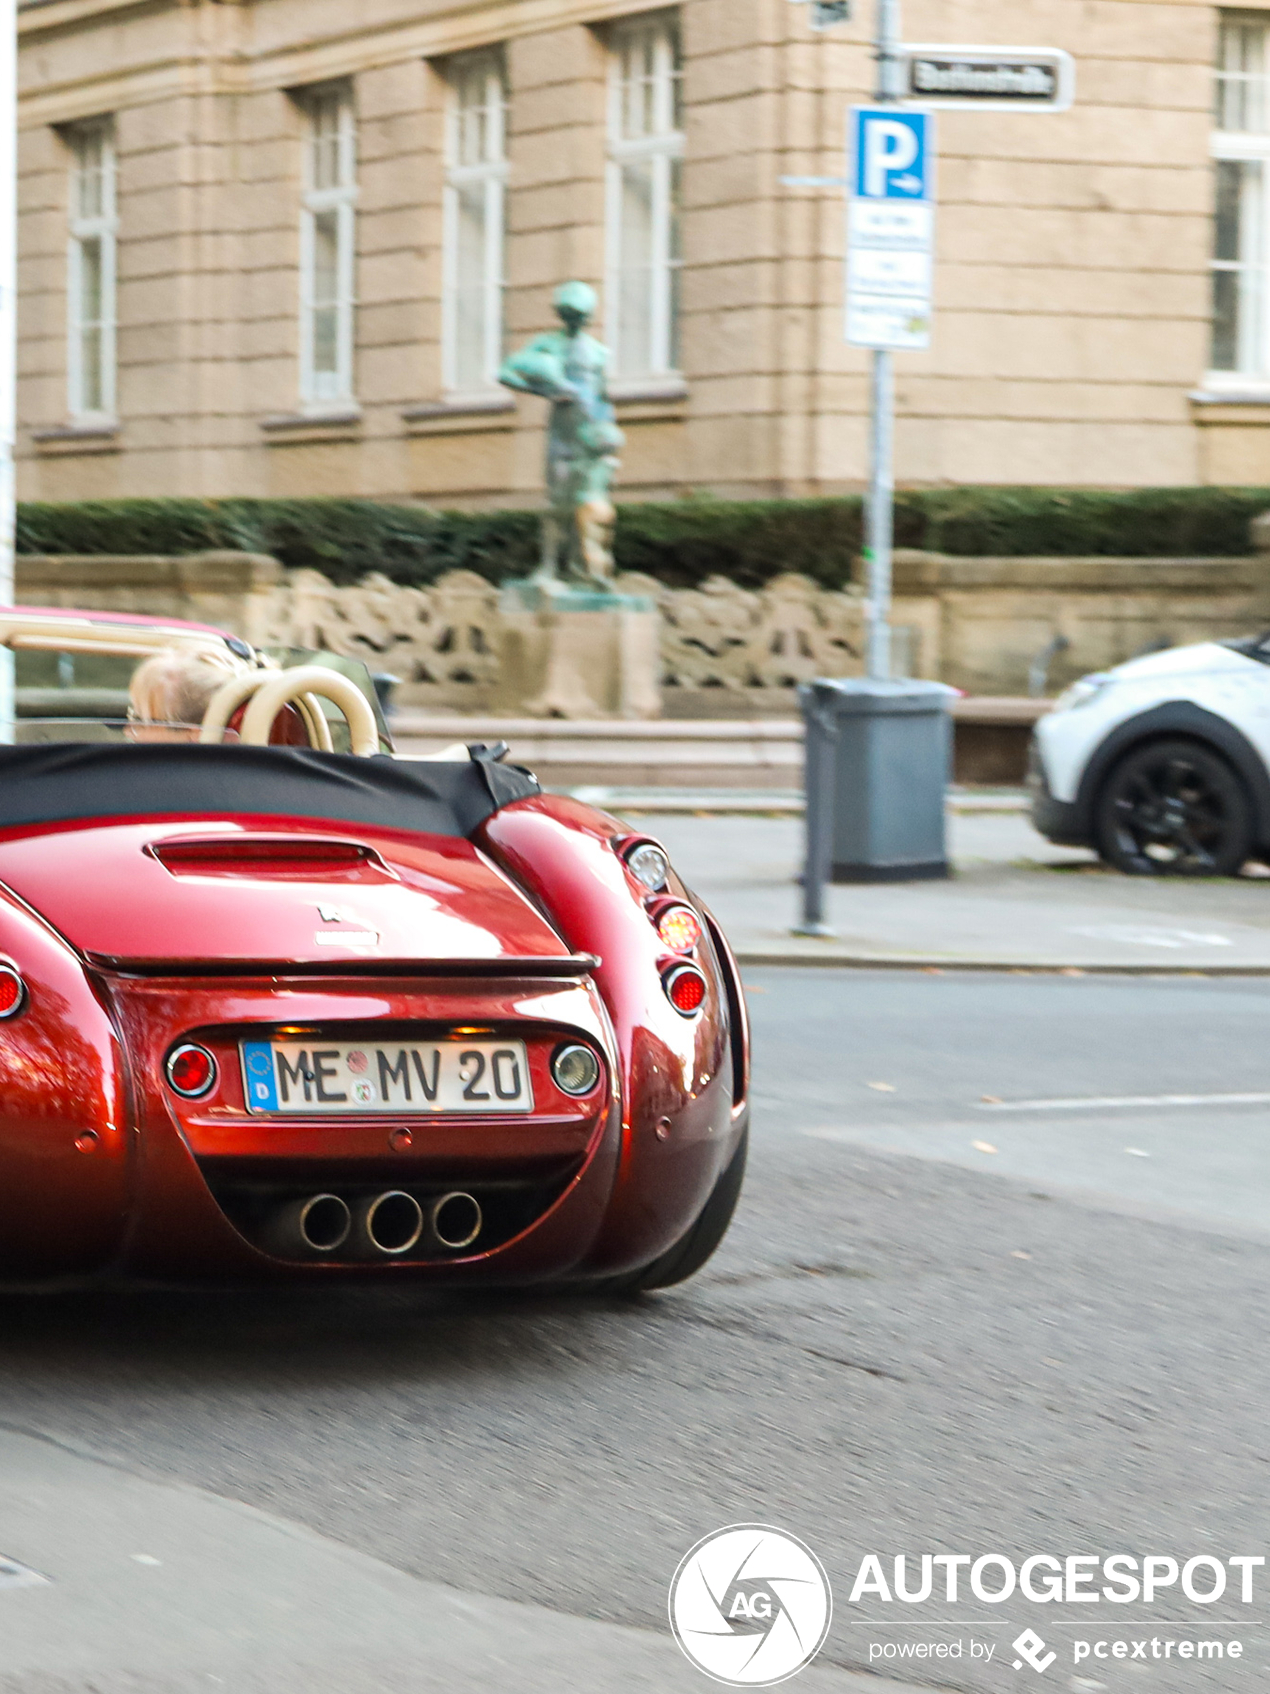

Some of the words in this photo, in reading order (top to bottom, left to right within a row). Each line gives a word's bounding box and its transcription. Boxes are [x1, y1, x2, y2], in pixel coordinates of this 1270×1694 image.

[863, 118, 919, 197] P
[256, 1082, 270, 1100] D
[276, 1050, 347, 1102] ME
[378, 1049, 440, 1101] MV
[459, 1050, 522, 1101] 20
